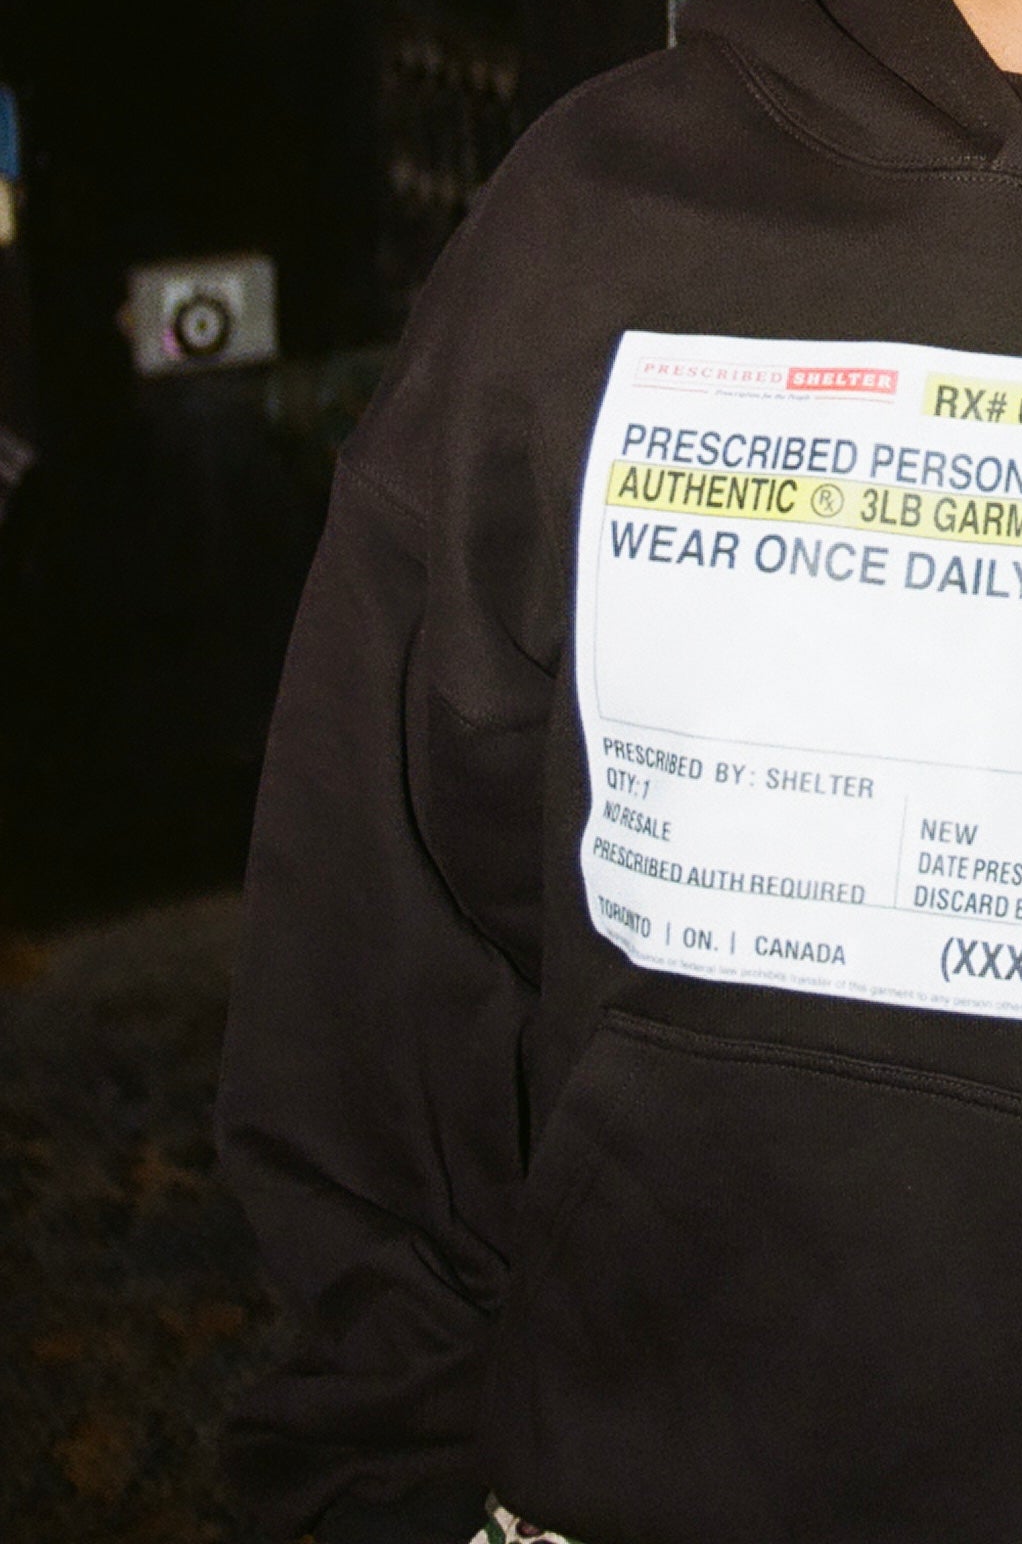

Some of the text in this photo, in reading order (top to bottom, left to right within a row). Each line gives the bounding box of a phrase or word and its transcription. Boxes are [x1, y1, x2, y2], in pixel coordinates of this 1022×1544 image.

[644, 363, 893, 390] PRESCRIBED SHELTER
[933, 385, 1008, 423] RX#
[622, 423, 857, 474] PRESCRIBED
[618, 466, 798, 513] AUTHENTIC
[860, 488, 922, 527] 3LB
[611, 520, 740, 569] WEAR
[755, 533, 889, 586] ONCE
[603, 737, 703, 780] PRESCRIBED
[766, 768, 874, 799] SHELTER
[603, 800, 672, 842] NO RESALE
[921, 818, 979, 846] NEW
[593, 836, 866, 905] PRESCRIBED AUTH REQUIRED
[918, 851, 969, 879] DATE
[913, 885, 1009, 918] DISCARD
[598, 895, 651, 938] TORONTO
[683, 927, 718, 952] ON.
[755, 936, 846, 966] CANADA
